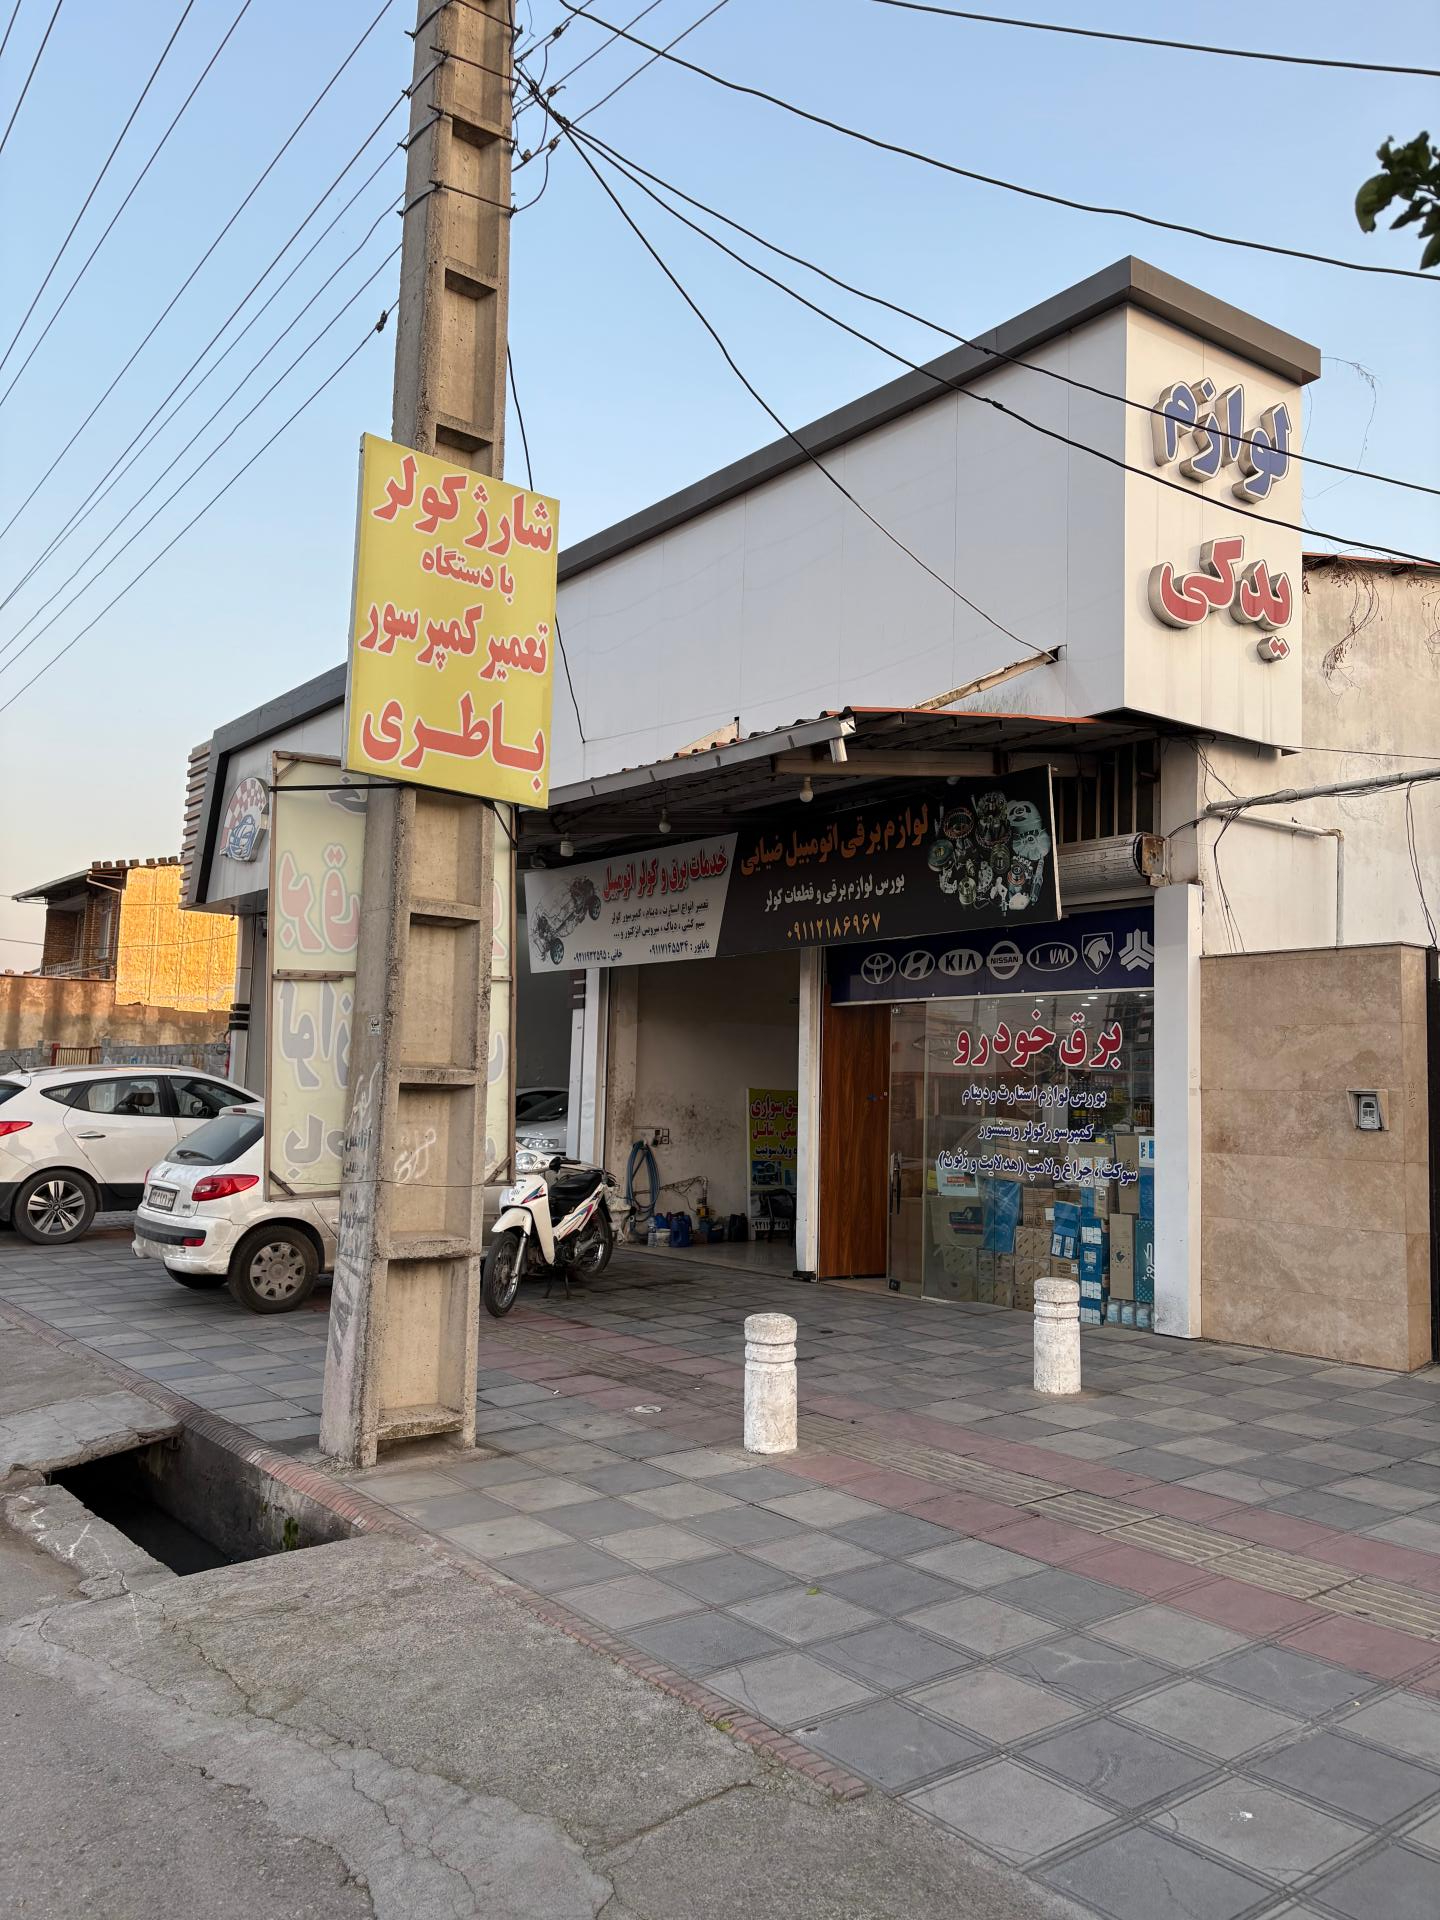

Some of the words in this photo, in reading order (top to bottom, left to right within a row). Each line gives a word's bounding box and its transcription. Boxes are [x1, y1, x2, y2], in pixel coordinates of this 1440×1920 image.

[1155, 377, 1292, 501] لوازم
[371, 454, 468, 534] کولر
[462, 483, 554, 557] شارژ
[421, 544, 495, 591] دستگاه
[498, 563, 515, 604] با
[1157, 535, 1292, 661] یدکی
[478, 622, 549, 681] تعمیر
[360, 691, 546, 792] باطری
[841, 816, 882, 859] برقی
[884, 803, 929, 850] لوازم
[786, 822, 839, 867] اتومبیل
[637, 857, 658, 897] کولر
[669, 858, 689, 891] برق
[688, 846, 728, 880] خدمات
[603, 862, 637, 901] اتومبیل
[660, 865, 668, 895] و
[785, 882, 815, 904] قطعات
[823, 879, 847, 904] برقی
[848, 873, 873, 900] لوازم
[875, 874, 905, 897] بورس
[764, 888, 783, 912] کولر
[786, 911, 881, 941] ۰۹۱۱۲۱۸۶۹۶۷
[945, 953, 977, 971] KIA
[990, 956, 1019, 964] NISSAN
[953, 1009, 1056, 1067] خودرو
[1059, 1011, 1122, 1069] برق
[962, 1084, 990, 1106] دینام
[999, 1084, 1037, 1105] استارت
[1038, 1085, 1070, 1108] لوازم
[1069, 1090, 1107, 1108] بورس
[977, 1120, 1012, 1139] سنسور
[1021, 1121, 1046, 1142] کولر
[1045, 1123, 1094, 1145] کمپرسور
[1025, 1157, 1055, 1181] لامپ
[1062, 1156, 1093, 1184] چراغ
